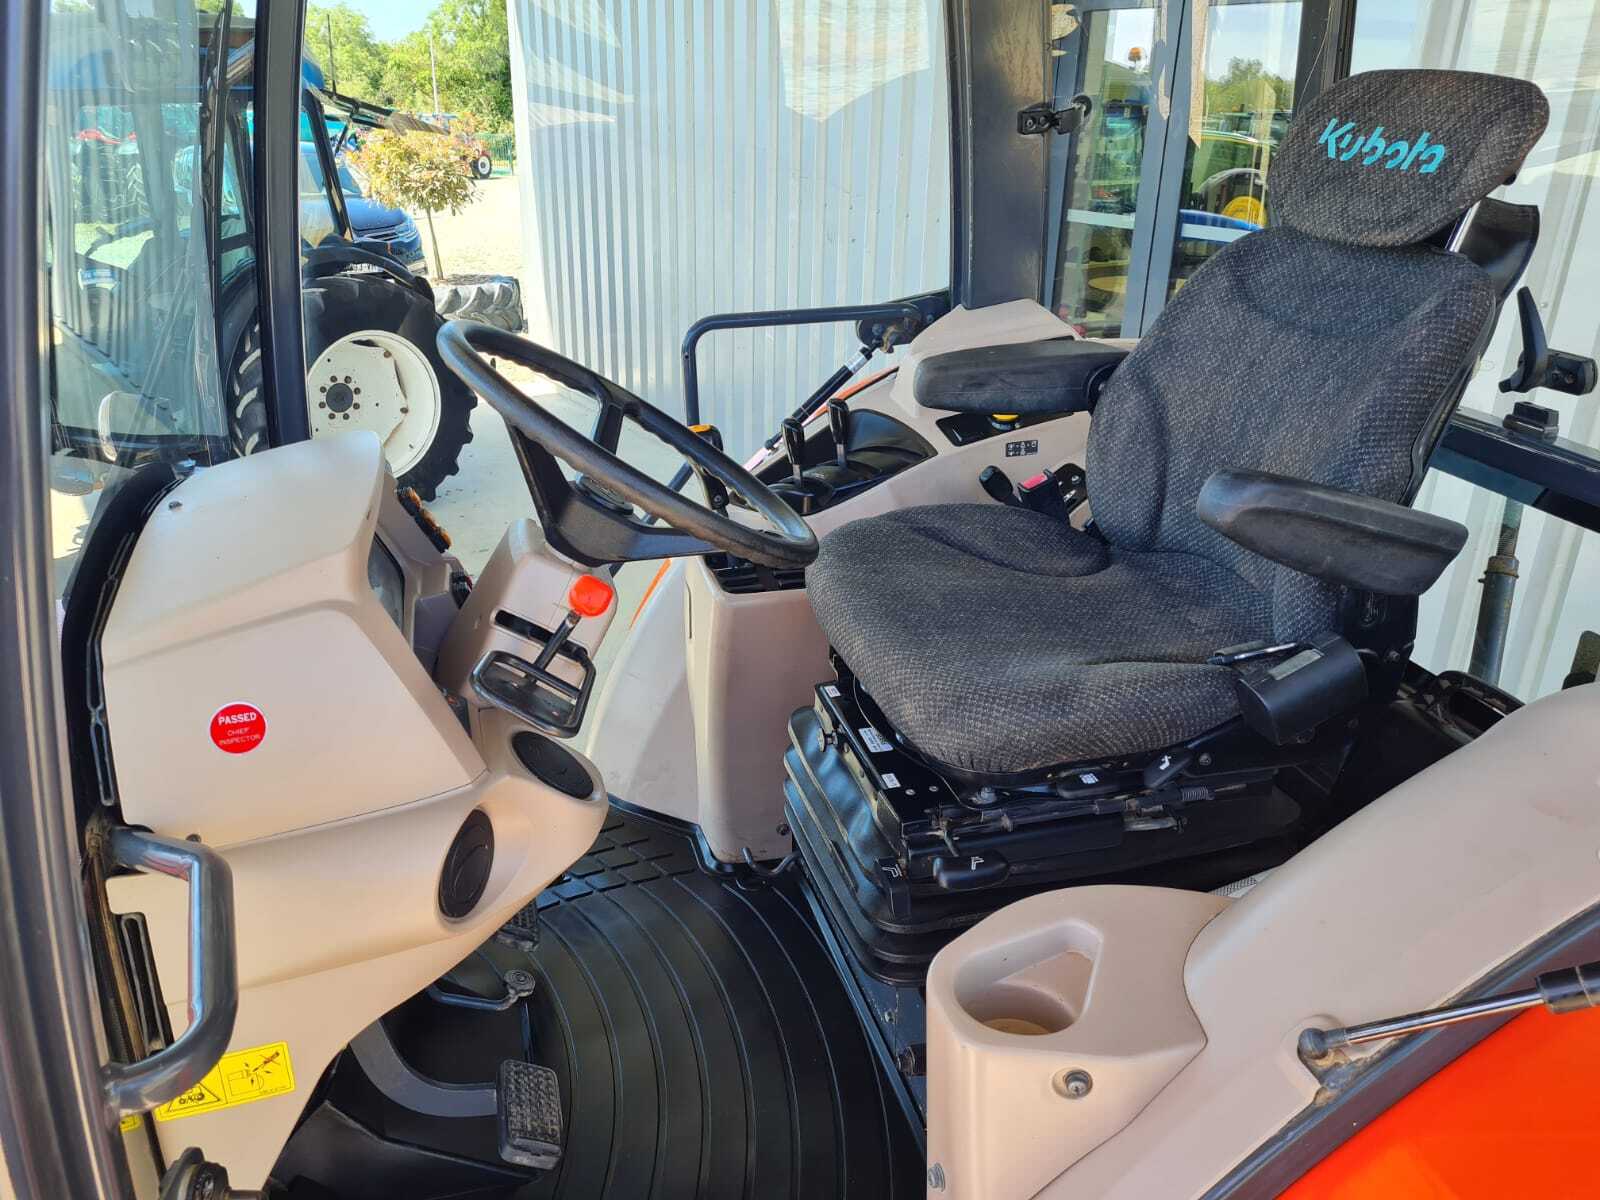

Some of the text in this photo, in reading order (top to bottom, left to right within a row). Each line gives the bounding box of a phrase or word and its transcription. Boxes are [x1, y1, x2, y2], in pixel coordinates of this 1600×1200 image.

[1318, 117, 1447, 174] Kubota
[217, 711, 257, 726] PASSED
[226, 727, 250, 737] CHIEF
[219, 734, 261, 745] INSPECTOR
